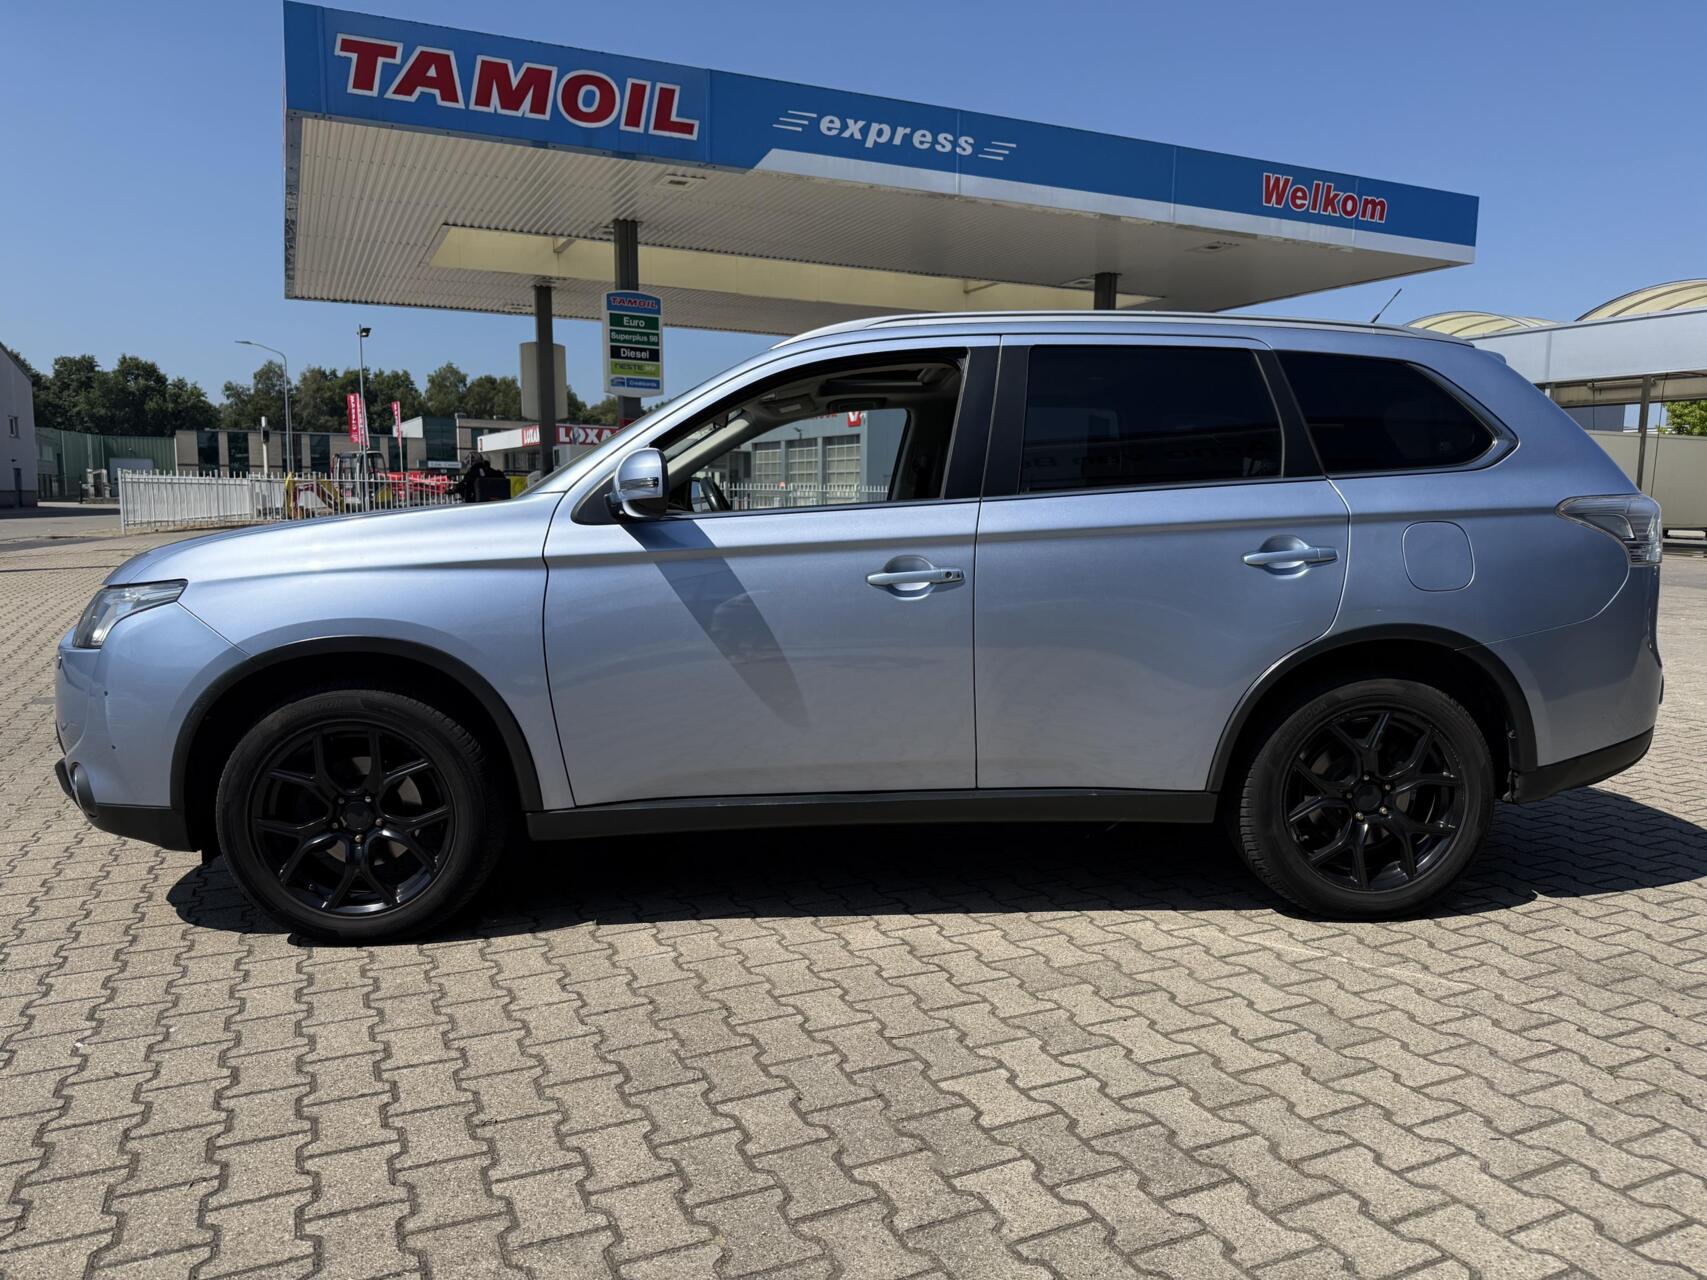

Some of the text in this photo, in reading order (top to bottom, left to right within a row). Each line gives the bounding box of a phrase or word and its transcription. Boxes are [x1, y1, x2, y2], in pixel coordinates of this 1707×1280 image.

[334, 33, 700, 141] TAMOIL
[819, 115, 975, 156] express
[1262, 172, 1388, 224] Welkom
[610, 296, 658, 309] TAMOIL
[623, 317, 645, 328] Euro
[611, 332, 648, 343] Superplus
[620, 348, 650, 359] Diesel
[559, 427, 620, 444] LOXA
